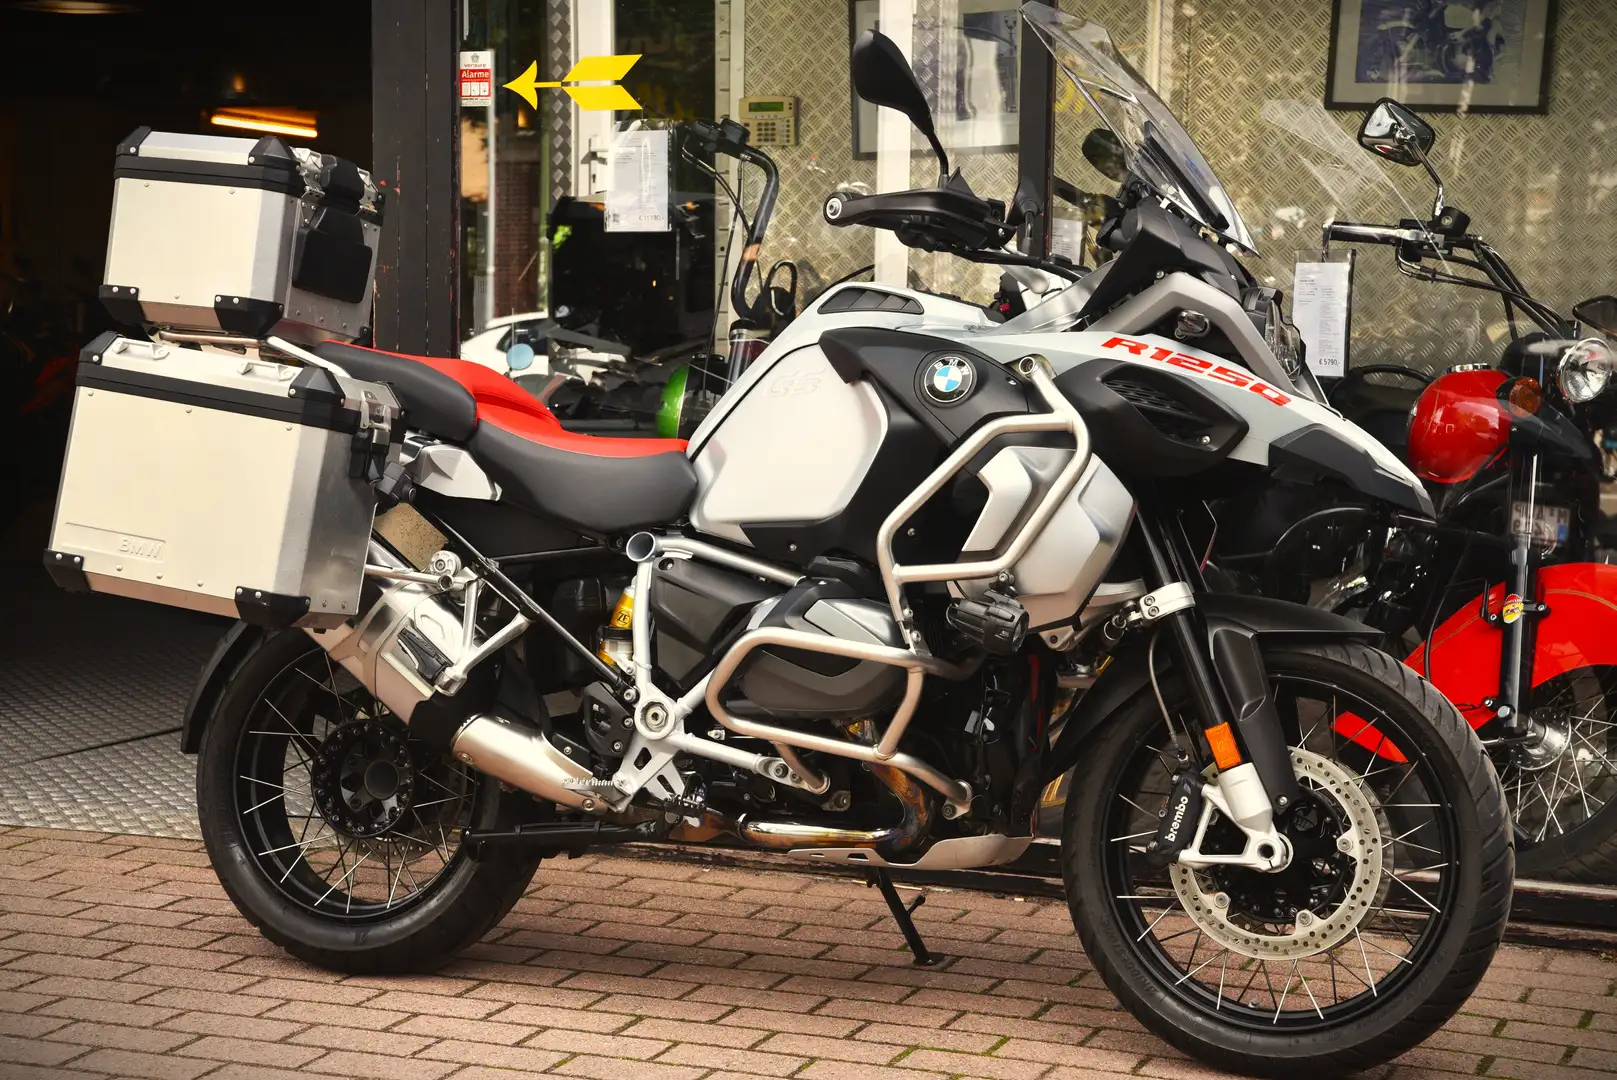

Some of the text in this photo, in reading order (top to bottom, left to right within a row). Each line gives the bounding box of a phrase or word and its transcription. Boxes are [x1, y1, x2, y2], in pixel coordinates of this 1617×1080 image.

[461, 70, 490, 79] Alarme
[934, 359, 970, 376] BMW
[1324, 358, 1341, 367] 5790,-
[1101, 337, 1292, 407] R1250
[118, 537, 163, 559] BMW
[617, 612, 629, 622] ZF
[1164, 796, 1189, 842] brembo
